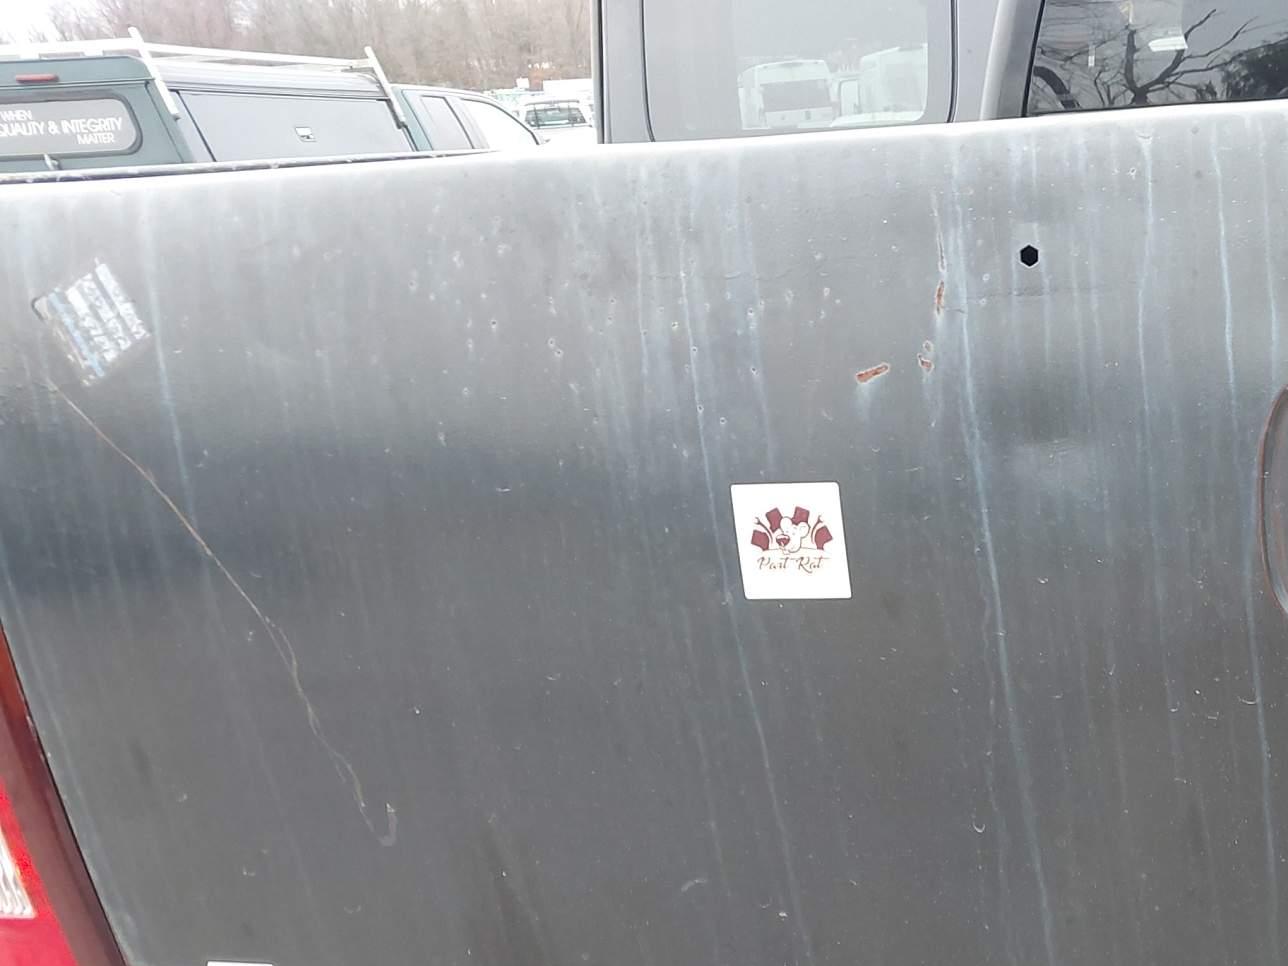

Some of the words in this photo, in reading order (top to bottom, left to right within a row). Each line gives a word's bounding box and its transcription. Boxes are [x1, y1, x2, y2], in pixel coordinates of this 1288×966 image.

[0, 109, 33, 121] WHEN
[48, 120, 60, 134] &
[61, 117, 122, 133] INTEGRITY
[76, 132, 115, 144] MATTER
